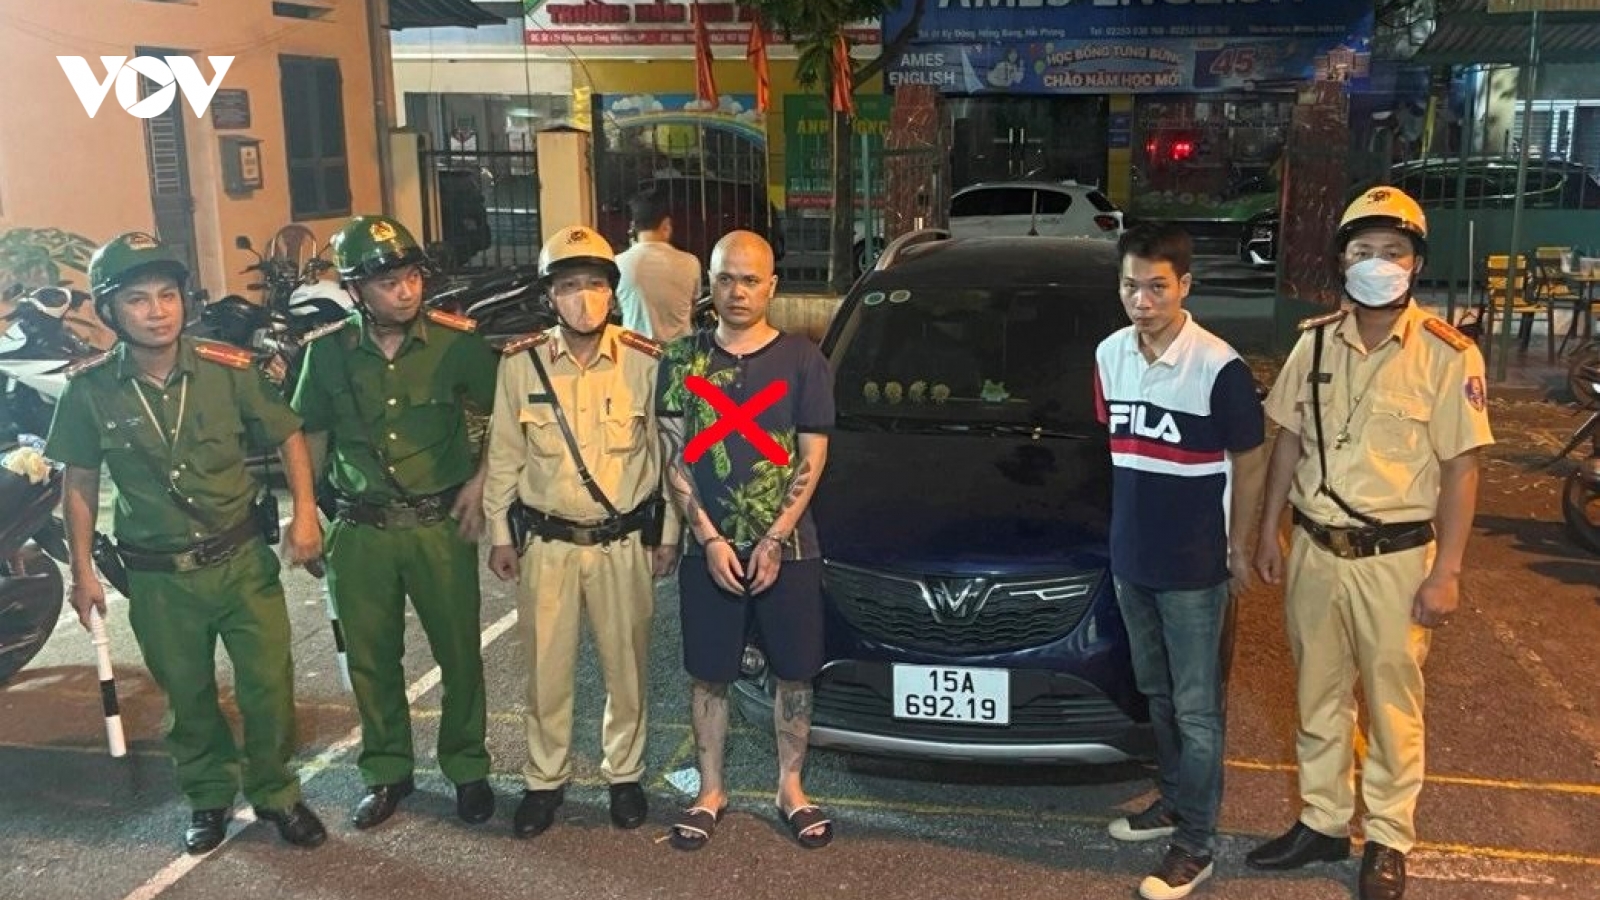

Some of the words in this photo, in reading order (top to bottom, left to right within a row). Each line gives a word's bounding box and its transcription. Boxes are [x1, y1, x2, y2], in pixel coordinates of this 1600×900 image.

[900, 53, 945, 67] AMES
[889, 71, 956, 86] ENGLISH
[1109, 404, 1182, 443] FILA
[929, 670, 975, 693] 15A
[905, 694, 996, 720] 692.19
